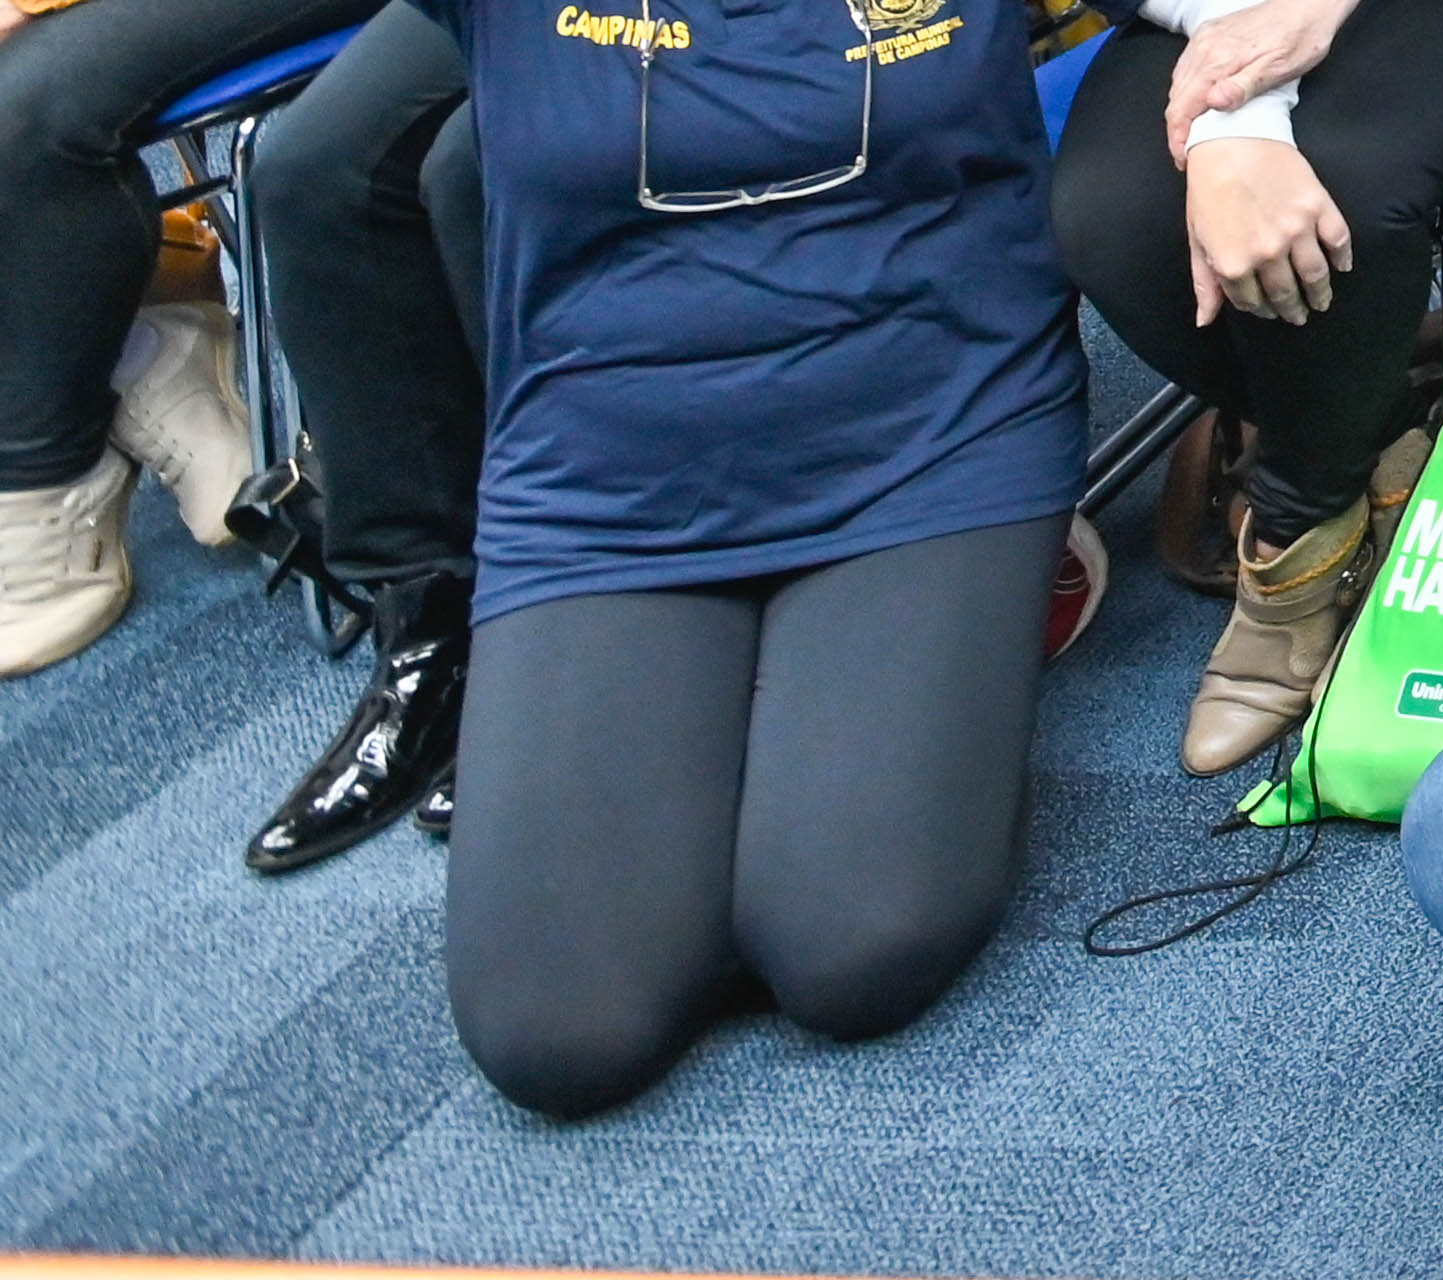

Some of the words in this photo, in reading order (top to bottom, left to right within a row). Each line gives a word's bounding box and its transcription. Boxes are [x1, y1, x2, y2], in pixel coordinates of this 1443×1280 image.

[556, 5, 692, 49] CAMPINAS
[878, 50, 896, 66] DE
[896, 32, 951, 60] CAMPINAS
